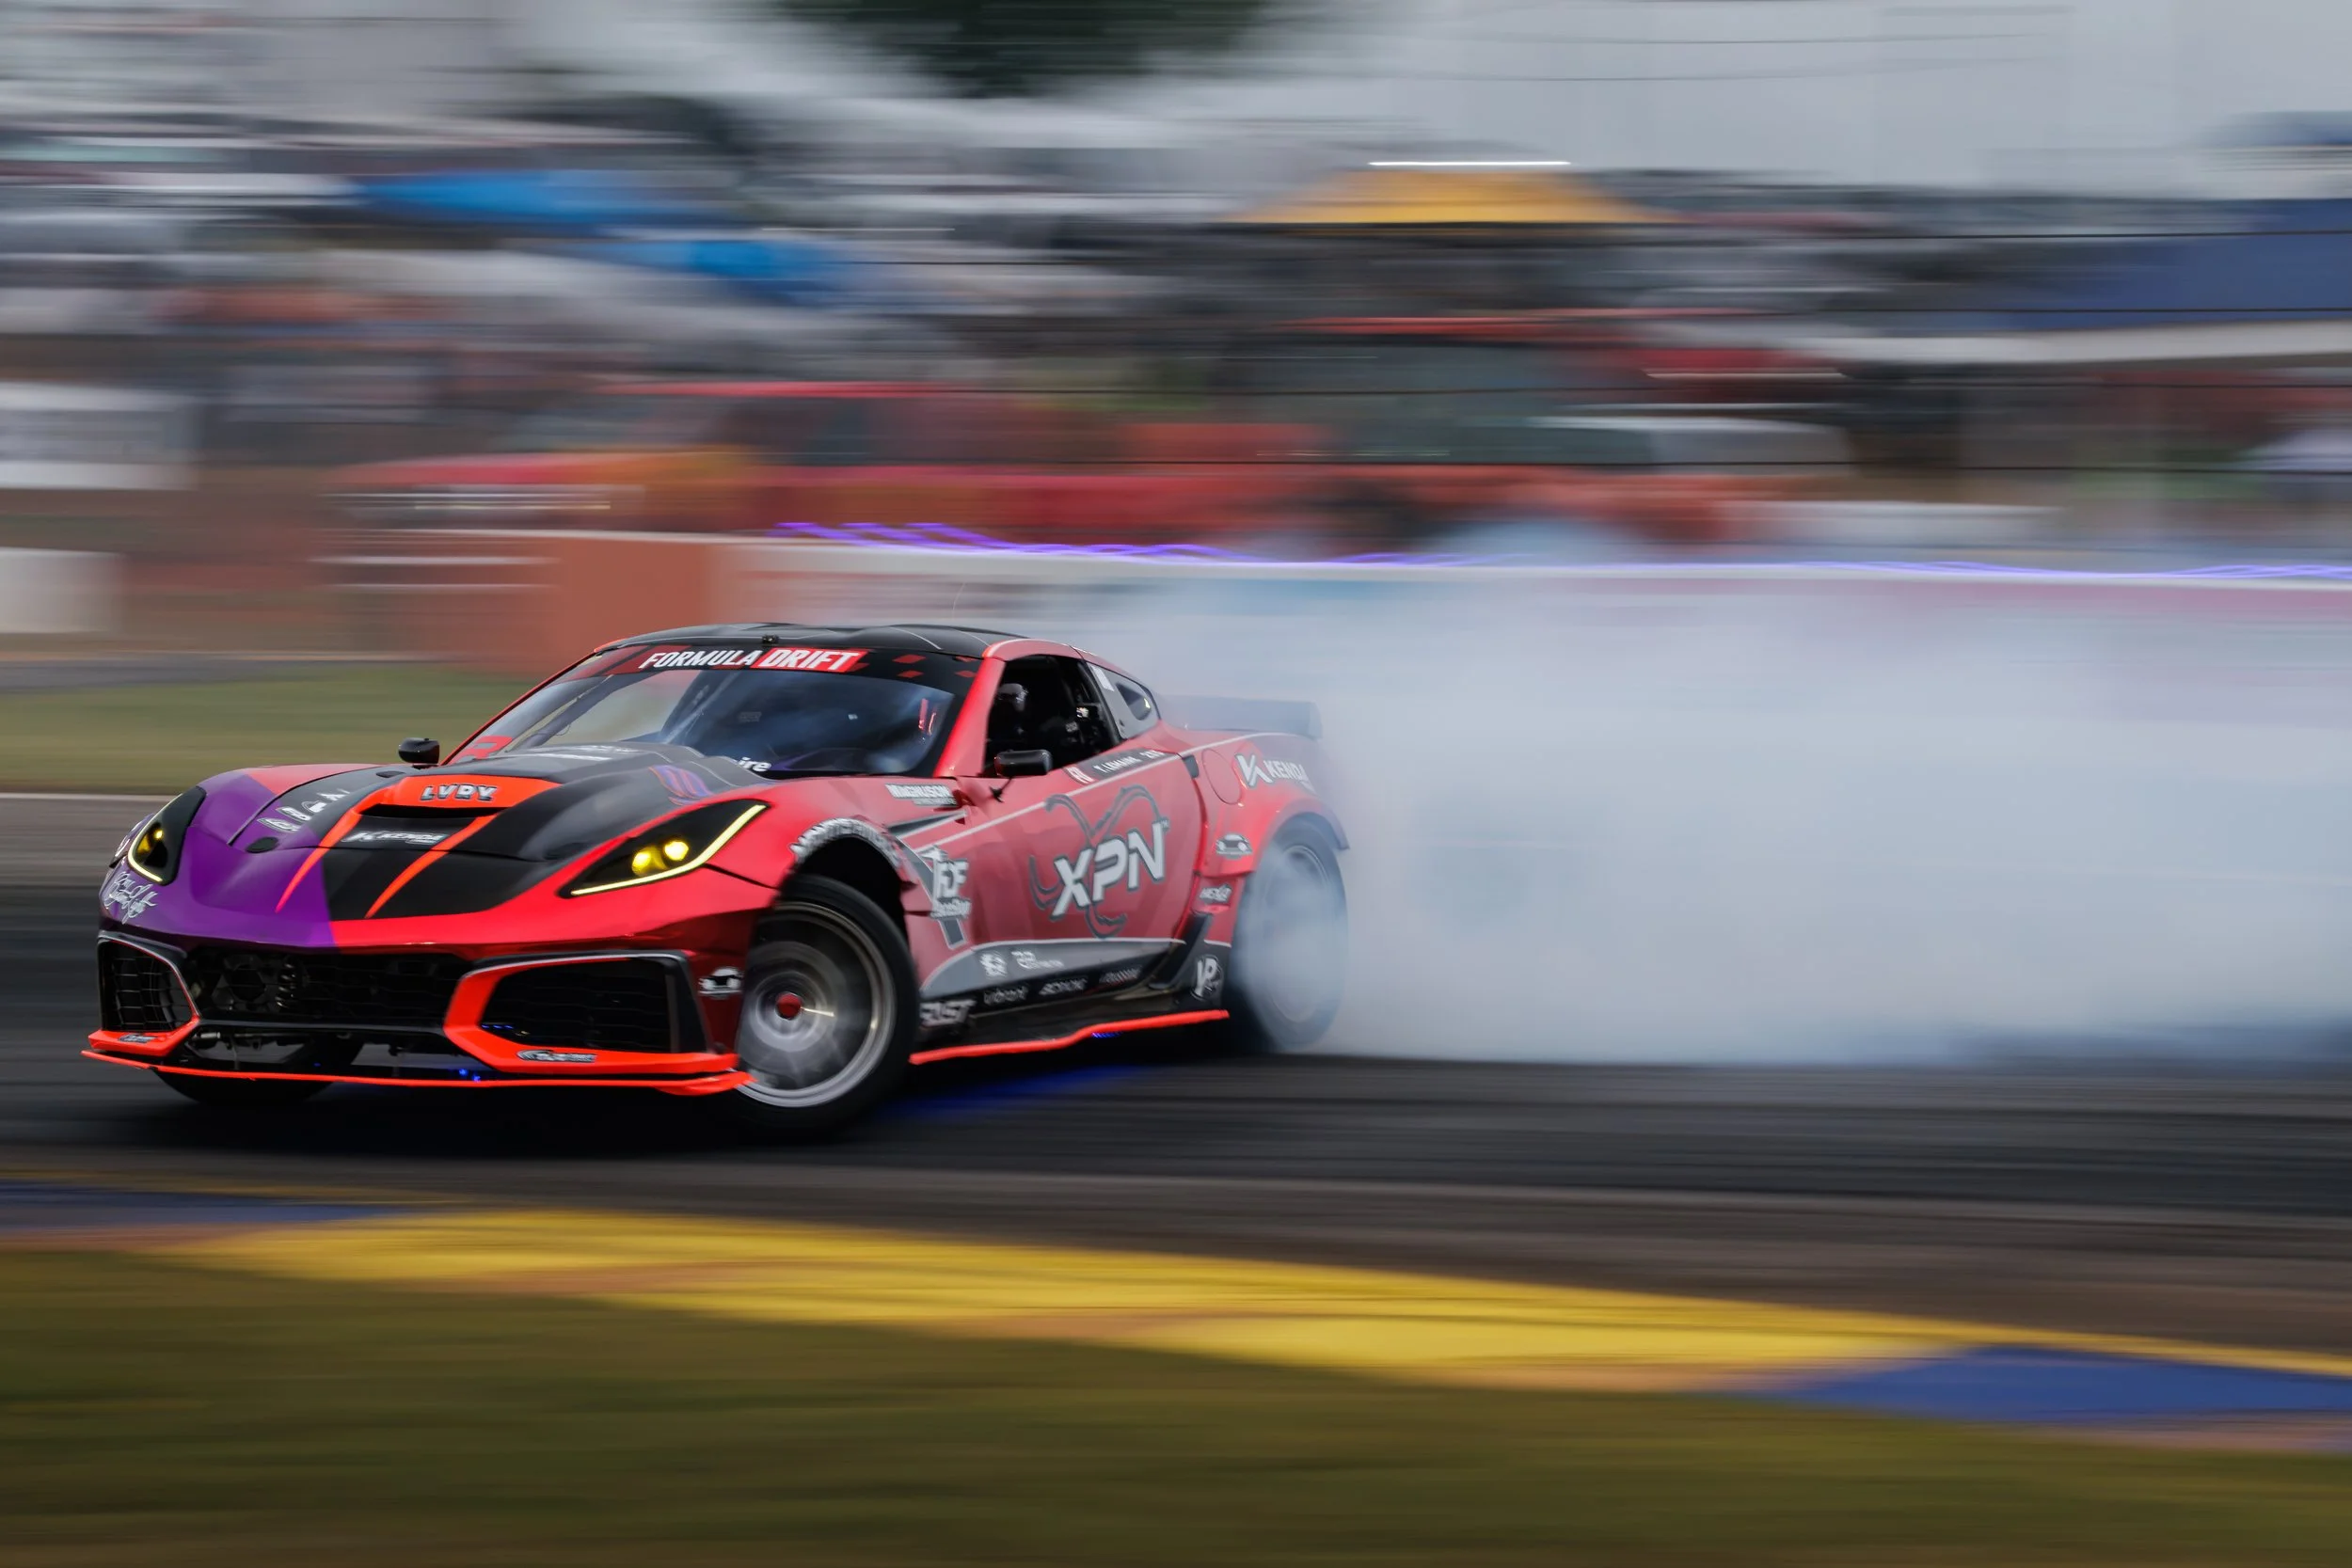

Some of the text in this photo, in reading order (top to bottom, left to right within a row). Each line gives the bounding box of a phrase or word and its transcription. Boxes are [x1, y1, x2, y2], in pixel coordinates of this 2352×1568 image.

[638, 649, 861, 671] FORMULA DRIFT
[738, 756, 772, 772] ire
[1050, 820, 1166, 920] XPN
